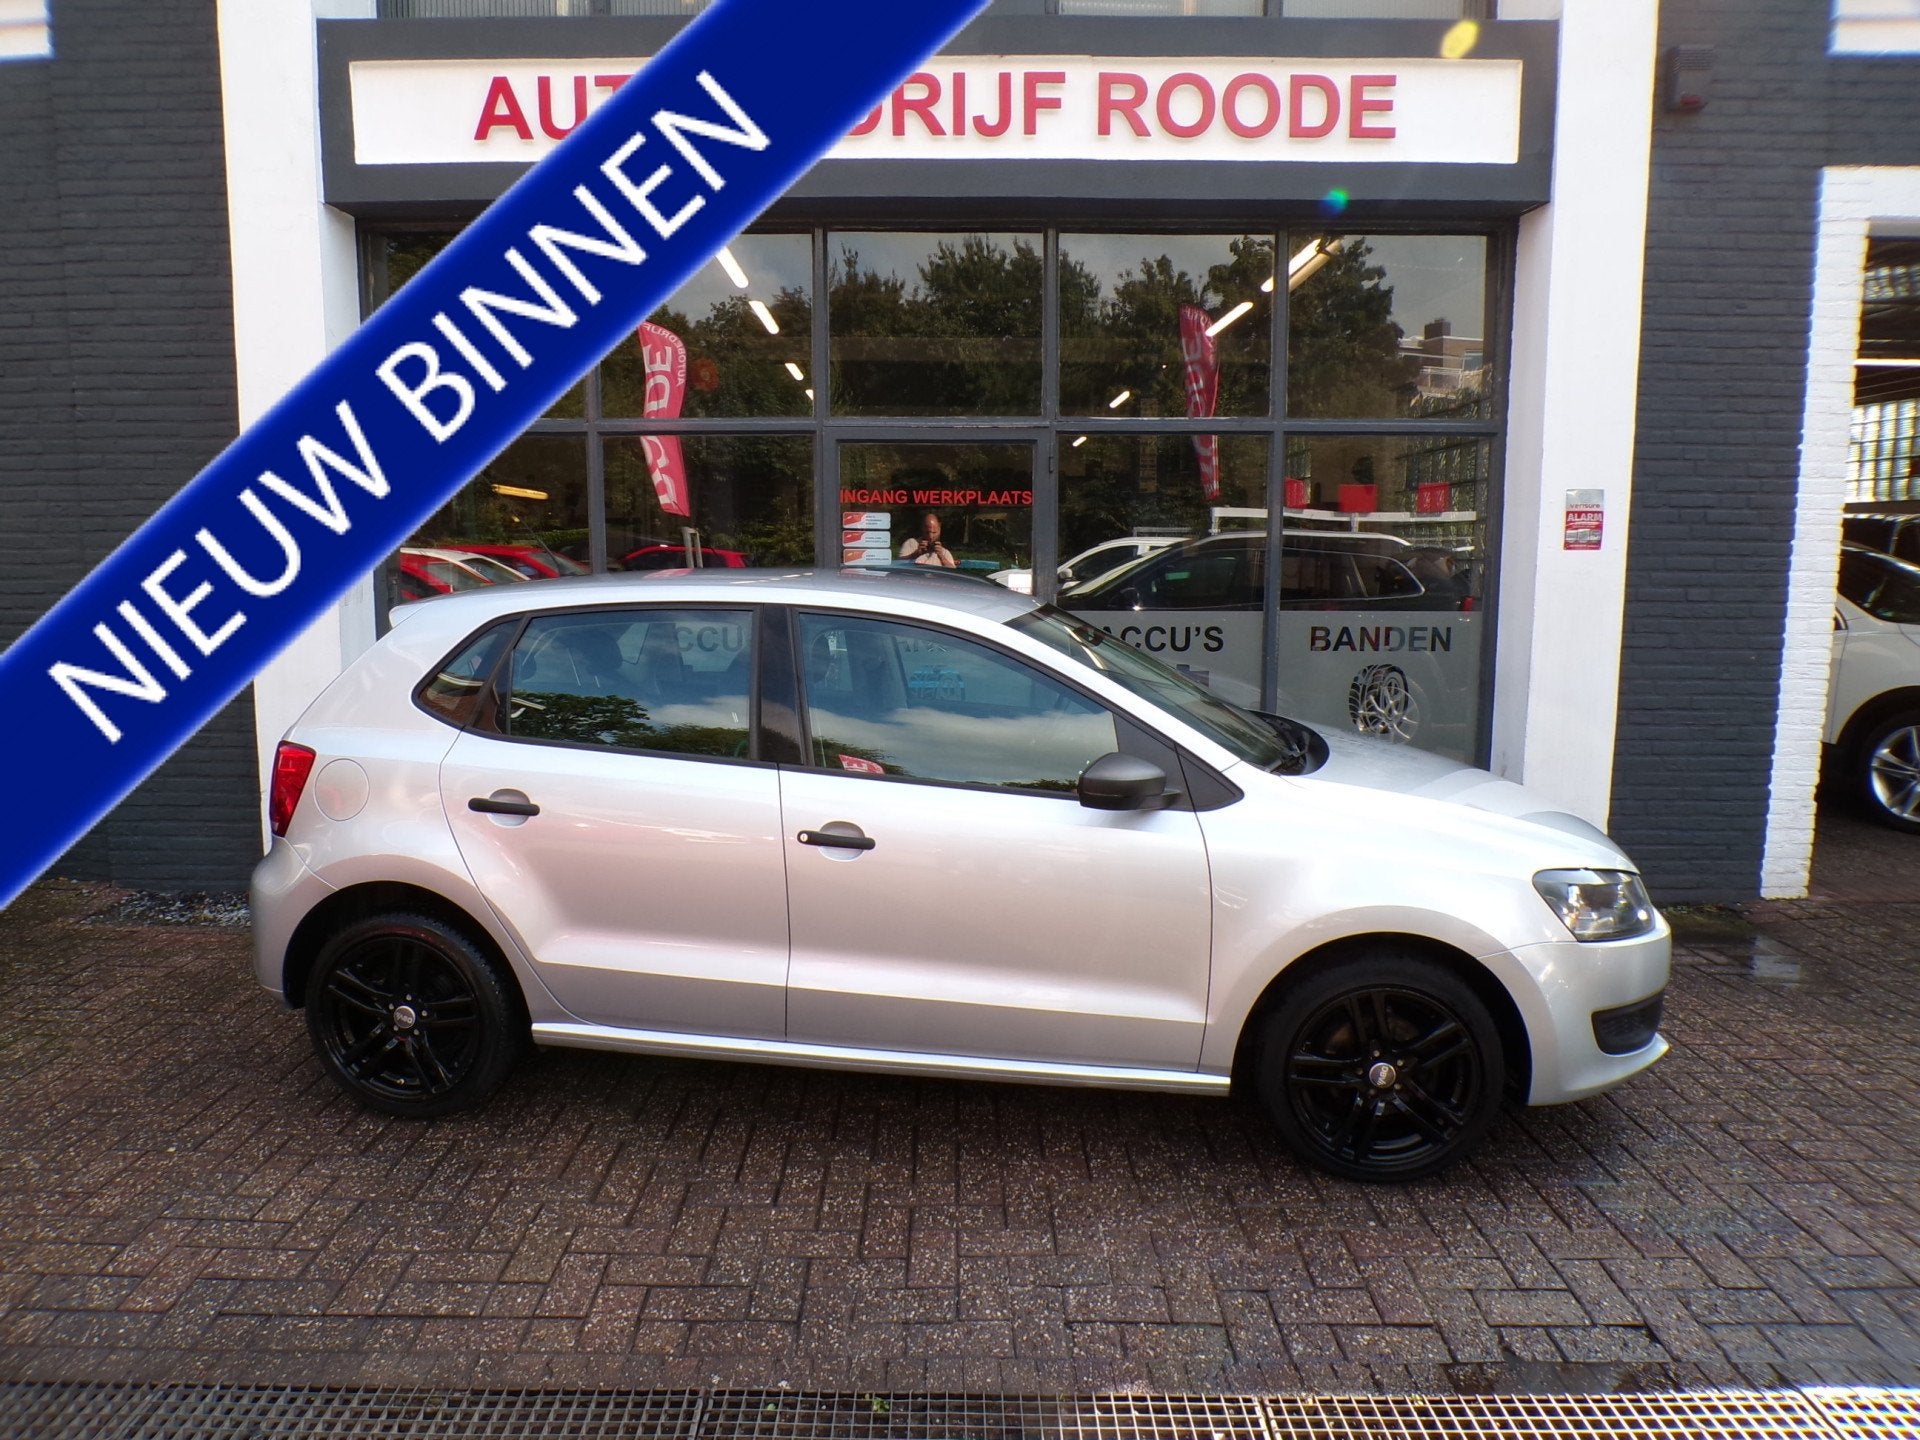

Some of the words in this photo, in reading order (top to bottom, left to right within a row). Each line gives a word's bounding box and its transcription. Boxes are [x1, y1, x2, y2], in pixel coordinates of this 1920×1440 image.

[475, 72, 1066, 141] AURIJF
[1097, 73, 1395, 139] ROODE
[840, 489, 908, 504] INGANG
[913, 490, 1033, 505] WERKPLAATS
[1567, 513, 1603, 521] ALARM
[1103, 625, 1225, 653] CCU'S
[1310, 626, 1452, 653] BANDEN
